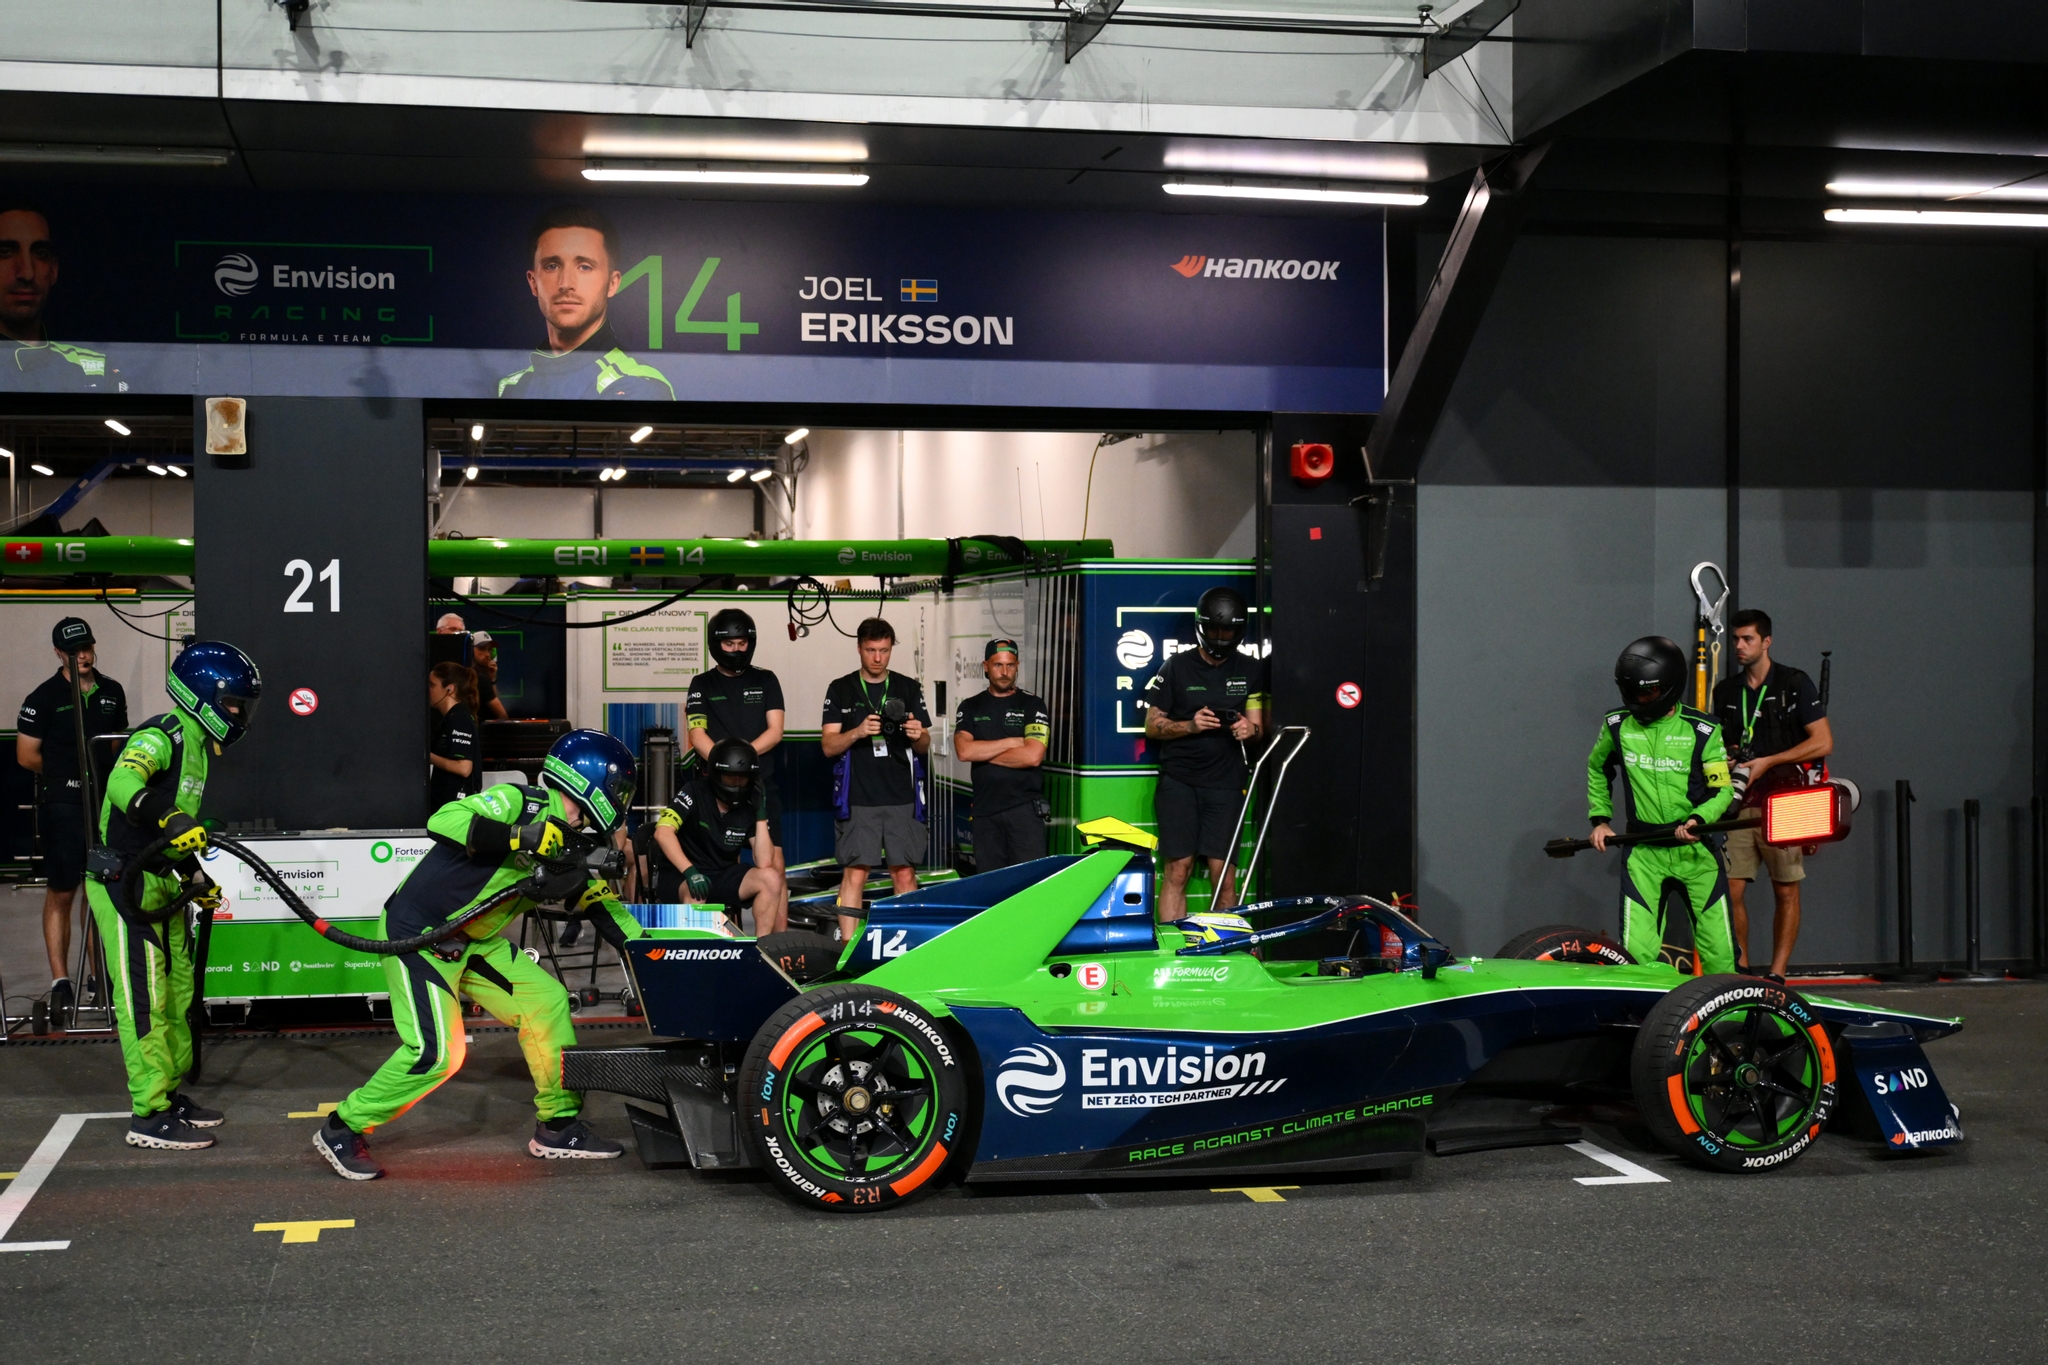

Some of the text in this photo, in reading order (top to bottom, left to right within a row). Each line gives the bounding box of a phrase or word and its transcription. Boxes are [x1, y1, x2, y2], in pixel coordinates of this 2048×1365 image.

[272, 264, 395, 290] Envision
[1203, 258, 1341, 280] HANKOOK
[798, 276, 883, 302] JOEL
[616, 255, 759, 351] 14
[214, 304, 395, 322] RACING
[240, 333, 309, 342] FORMULA
[334, 334, 372, 343] TEAM
[801, 312, 1013, 345] ERIKSSON
[54, 543, 86, 562] 16
[553, 546, 706, 566] ERI 14
[861, 549, 912, 561] Envision
[283, 558, 340, 613] 21
[1639, 754, 1683, 768] Envision
[276, 869, 324, 880] Envision
[1258, 900, 1273, 909] ERI
[867, 928, 908, 960] 14
[1261, 930, 1286, 940] Envision
[663, 948, 743, 960] HANKOOK
[1561, 939, 1582, 956] F4
[344, 961, 375, 970] Superdry
[780, 954, 806, 972] R4
[1171, 966, 1214, 977] FORMULA
[1085, 967, 1099, 986] E
[1696, 987, 1765, 1022] HANKOOK
[892, 1006, 955, 1067] HANKOOK
[1082, 1046, 1266, 1087] Envision
[1874, 1067, 1928, 1095] SAND
[1087, 1088, 1232, 1106] NET ZERO TECH PARTNER
[1128, 1094, 1434, 1163] RACE AGAINST CLIMATE CHANGE
[1904, 1127, 1959, 1144] HANKOOK
[1742, 1133, 1810, 1168] HANKOOK
[764, 1135, 827, 1199] HANKOOK
[853, 1185, 881, 1205] R3
